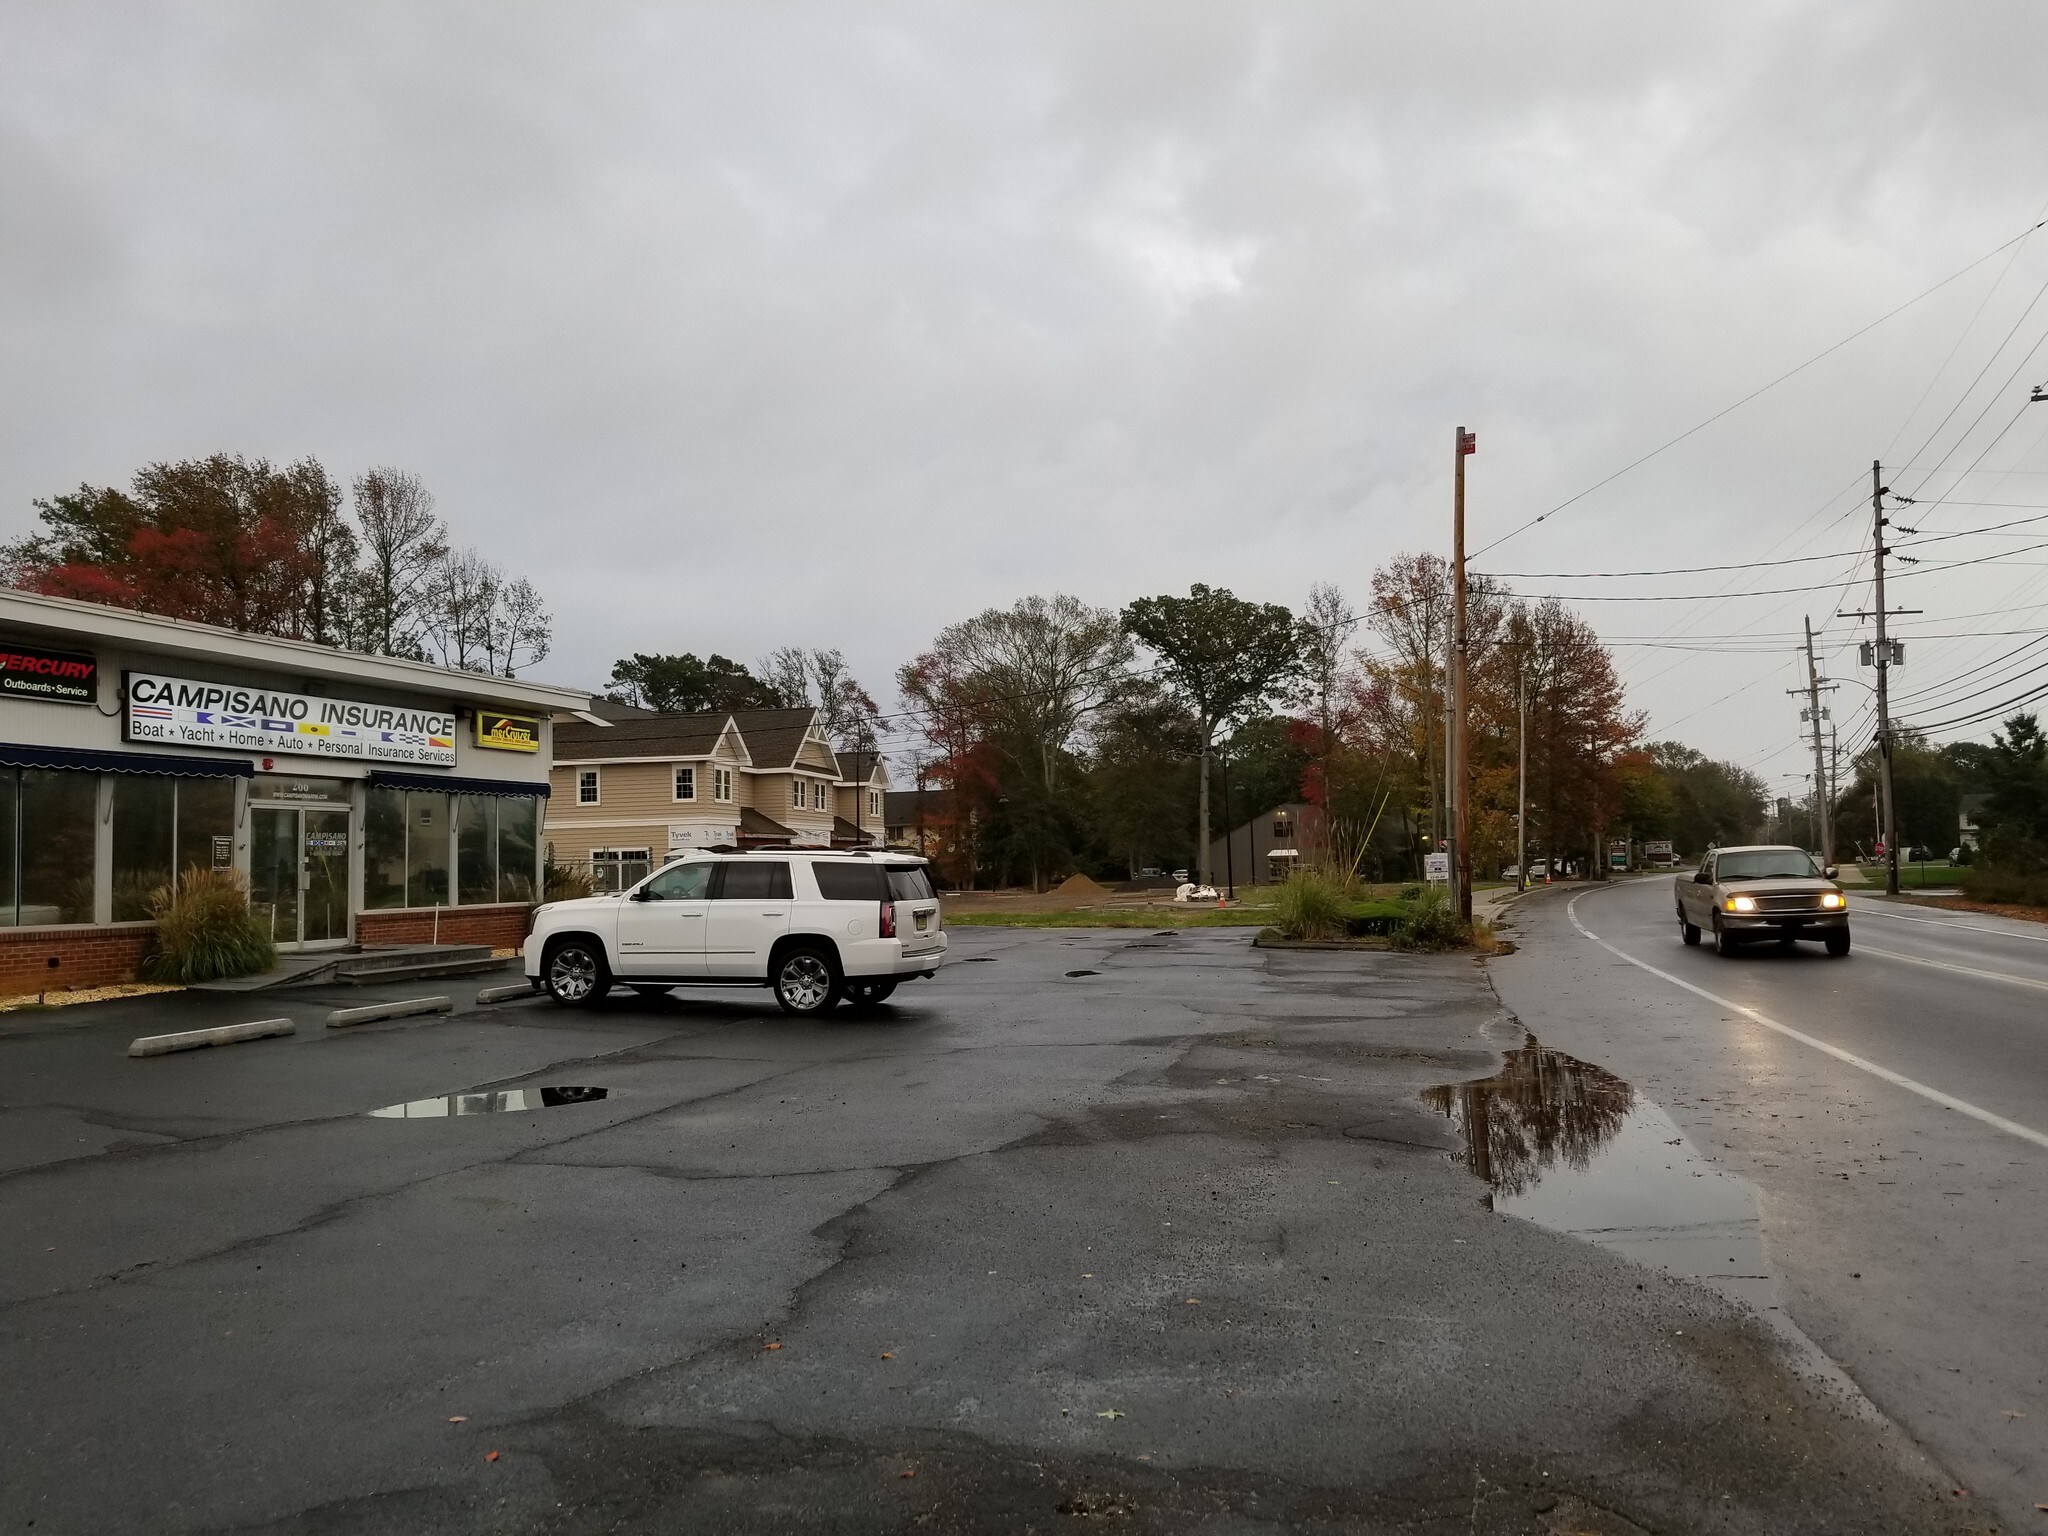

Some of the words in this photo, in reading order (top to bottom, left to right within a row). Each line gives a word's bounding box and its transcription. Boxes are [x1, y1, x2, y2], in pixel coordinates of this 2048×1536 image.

[4, 678, 52, 693] Outboards
[56, 684, 88, 697] Service
[131, 679, 308, 720] CAMPISANO
[320, 702, 455, 737] INSURANCE
[132, 720, 164, 737] Boat
[179, 725, 215, 742] Yacht
[229, 730, 264, 746] Home
[277, 735, 304, 750] Auto
[318, 738, 363, 755] Personal
[368, 744, 415, 759] Insurance
[418, 748, 455, 763] Services
[305, 832, 347, 840] CAMPISANO
